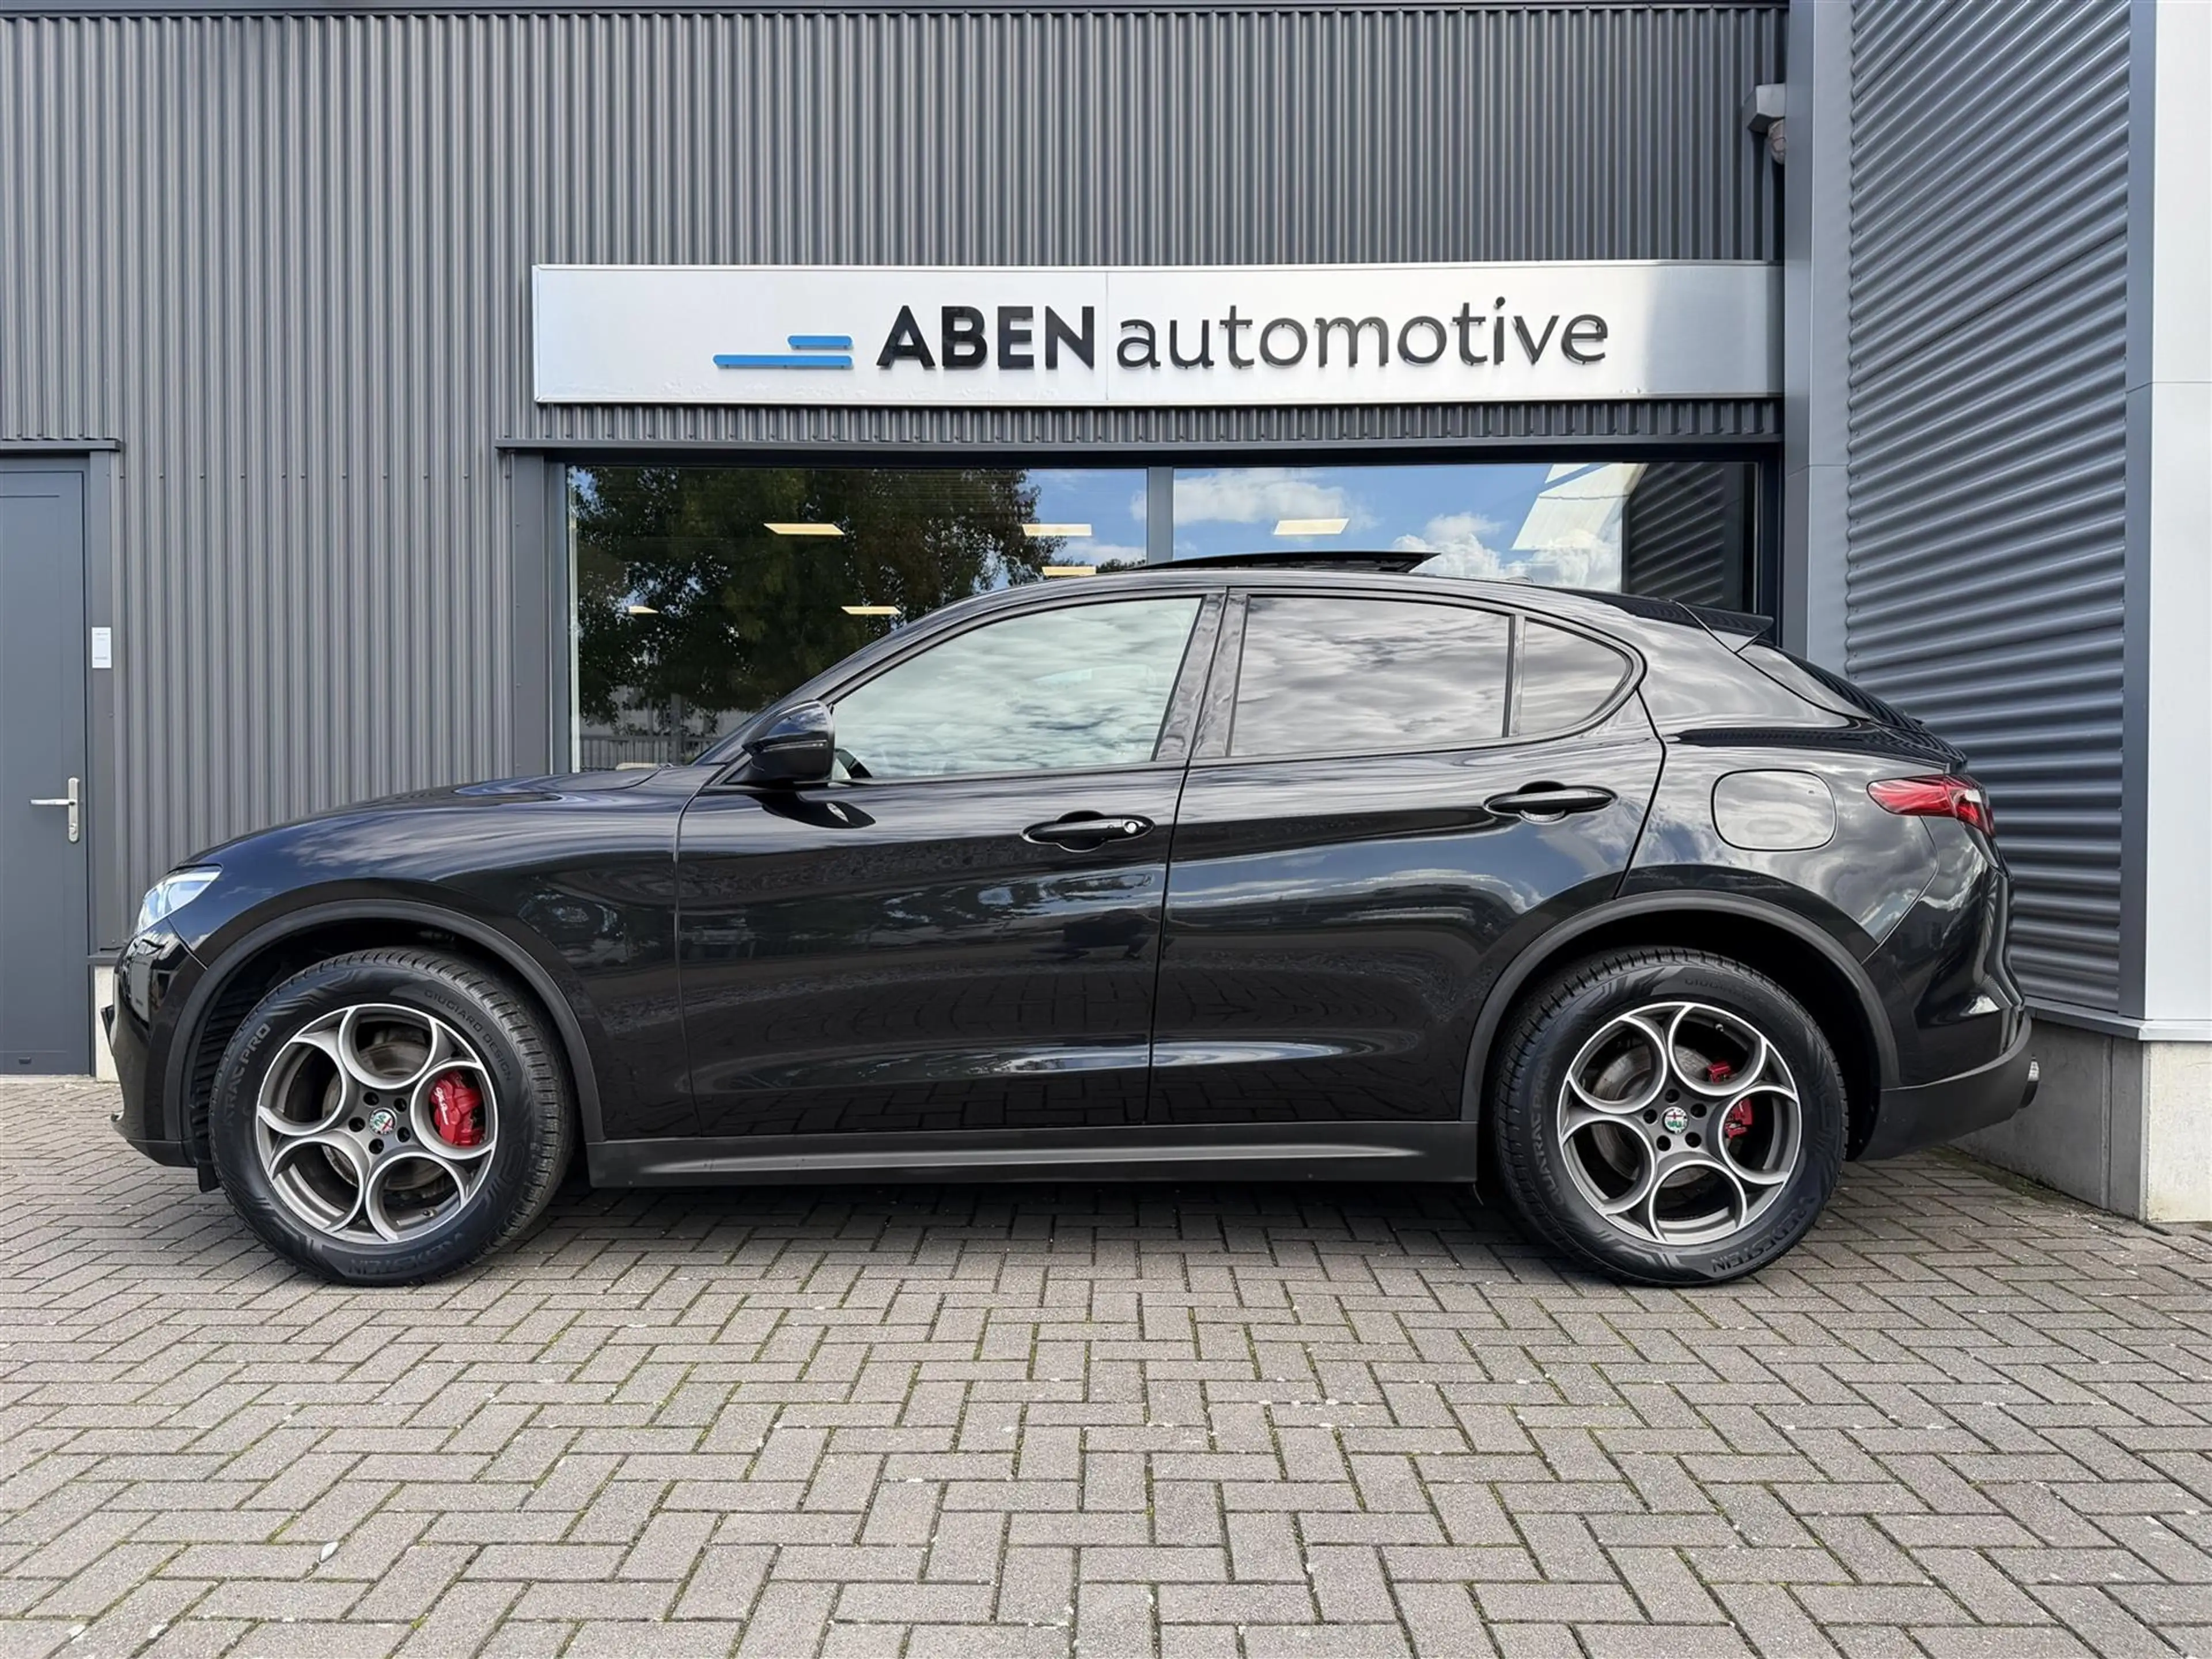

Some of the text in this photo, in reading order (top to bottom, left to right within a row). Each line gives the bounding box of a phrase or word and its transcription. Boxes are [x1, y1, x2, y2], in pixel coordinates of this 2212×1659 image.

[876, 296, 1608, 369] ABEN automotive
[239, 1022, 271, 1065] PRO
